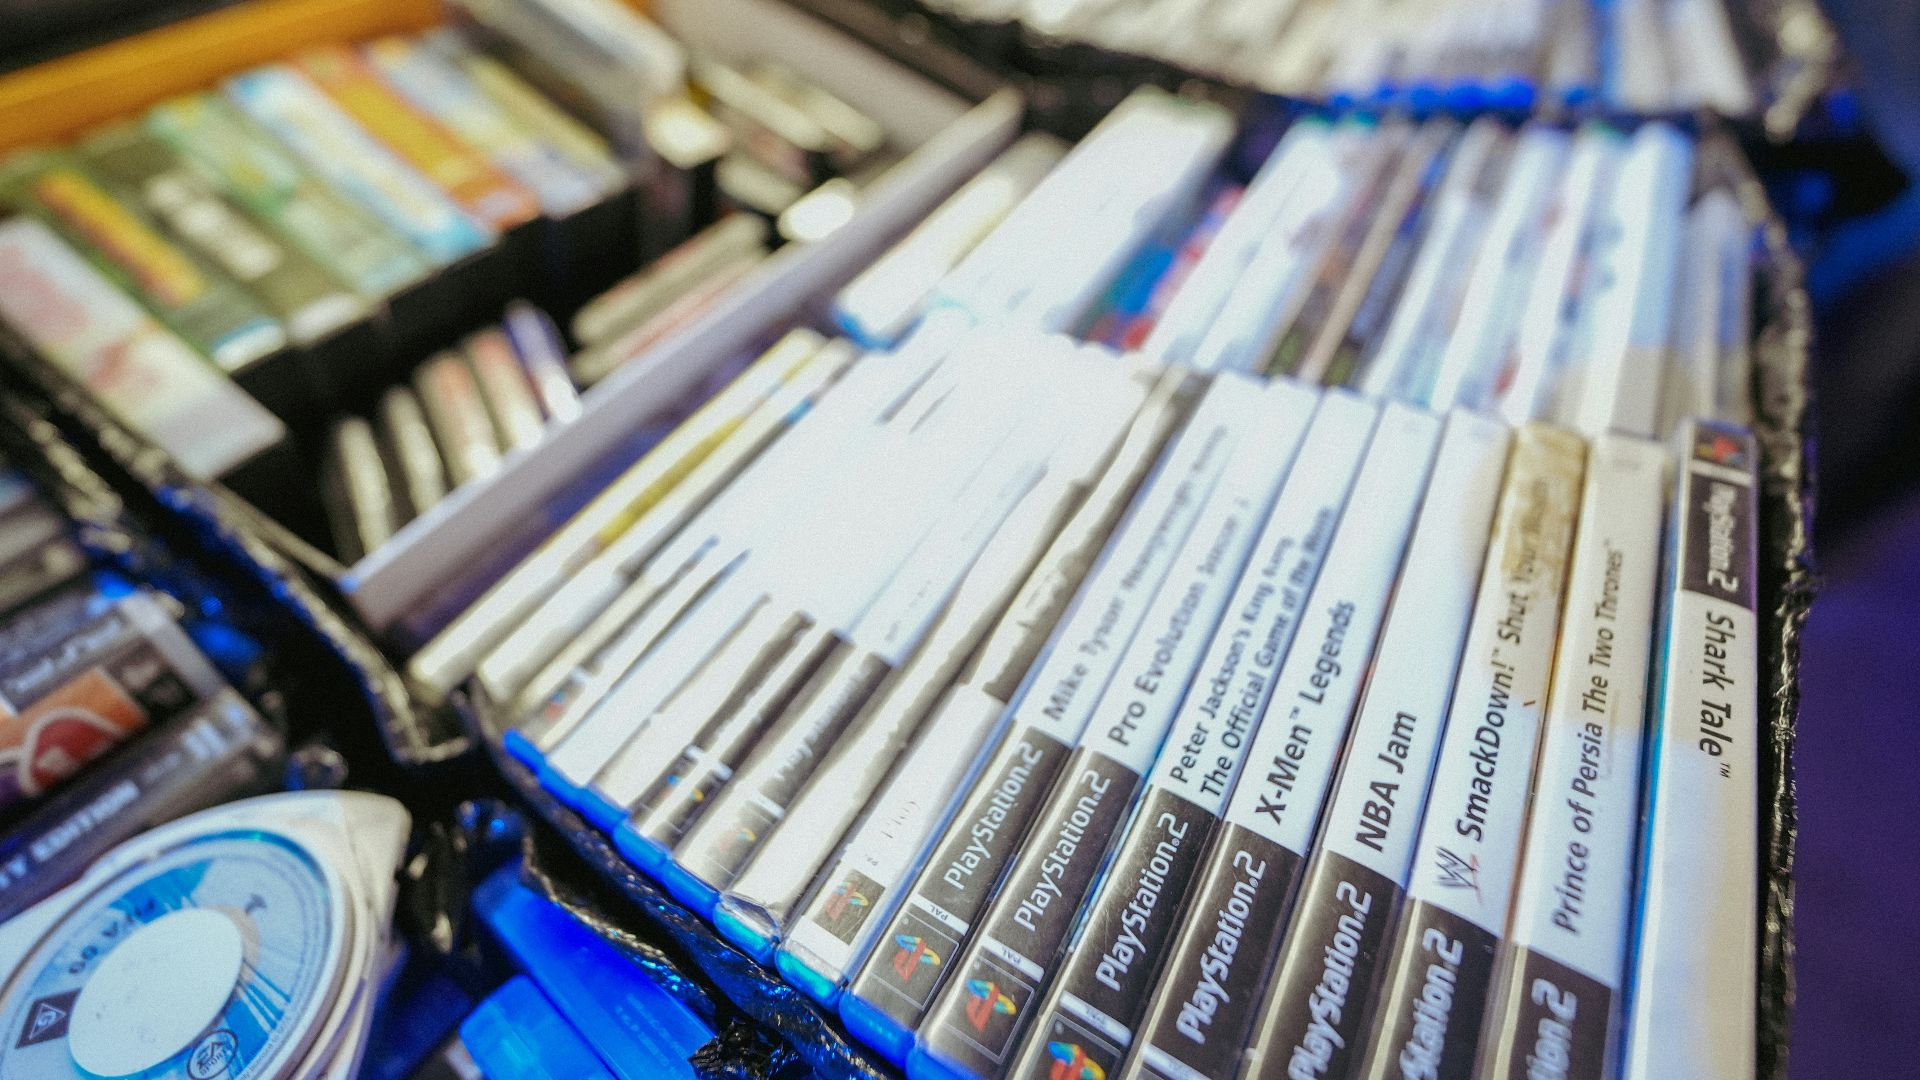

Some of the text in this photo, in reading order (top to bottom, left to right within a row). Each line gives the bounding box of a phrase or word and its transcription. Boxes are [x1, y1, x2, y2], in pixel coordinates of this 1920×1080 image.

[1042, 663, 1088, 721] Mike
[1079, 596, 1126, 653] Tyson
[1298, 600, 1356, 706] Legends
[1498, 590, 1531, 646] Shut
[1587, 626, 1616, 670] Two
[1702, 610, 1736, 691] Shark
[1107, 699, 1147, 747] Pro
[1134, 581, 1207, 695] Evolution
[1169, 722, 1209, 784] Peter
[1200, 630, 1252, 720] Jackson's
[1200, 752, 1232, 799] The
[1221, 670, 1267, 750] Official
[1254, 611, 1291, 669] Game
[1581, 673, 1610, 717] The
[1354, 708, 1418, 853] NBA Jam
[1571, 722, 1604, 799] Persia
[1571, 799, 1595, 836] of
[929, 903, 950, 922] PAL
[1551, 840, 1592, 936] Prince
